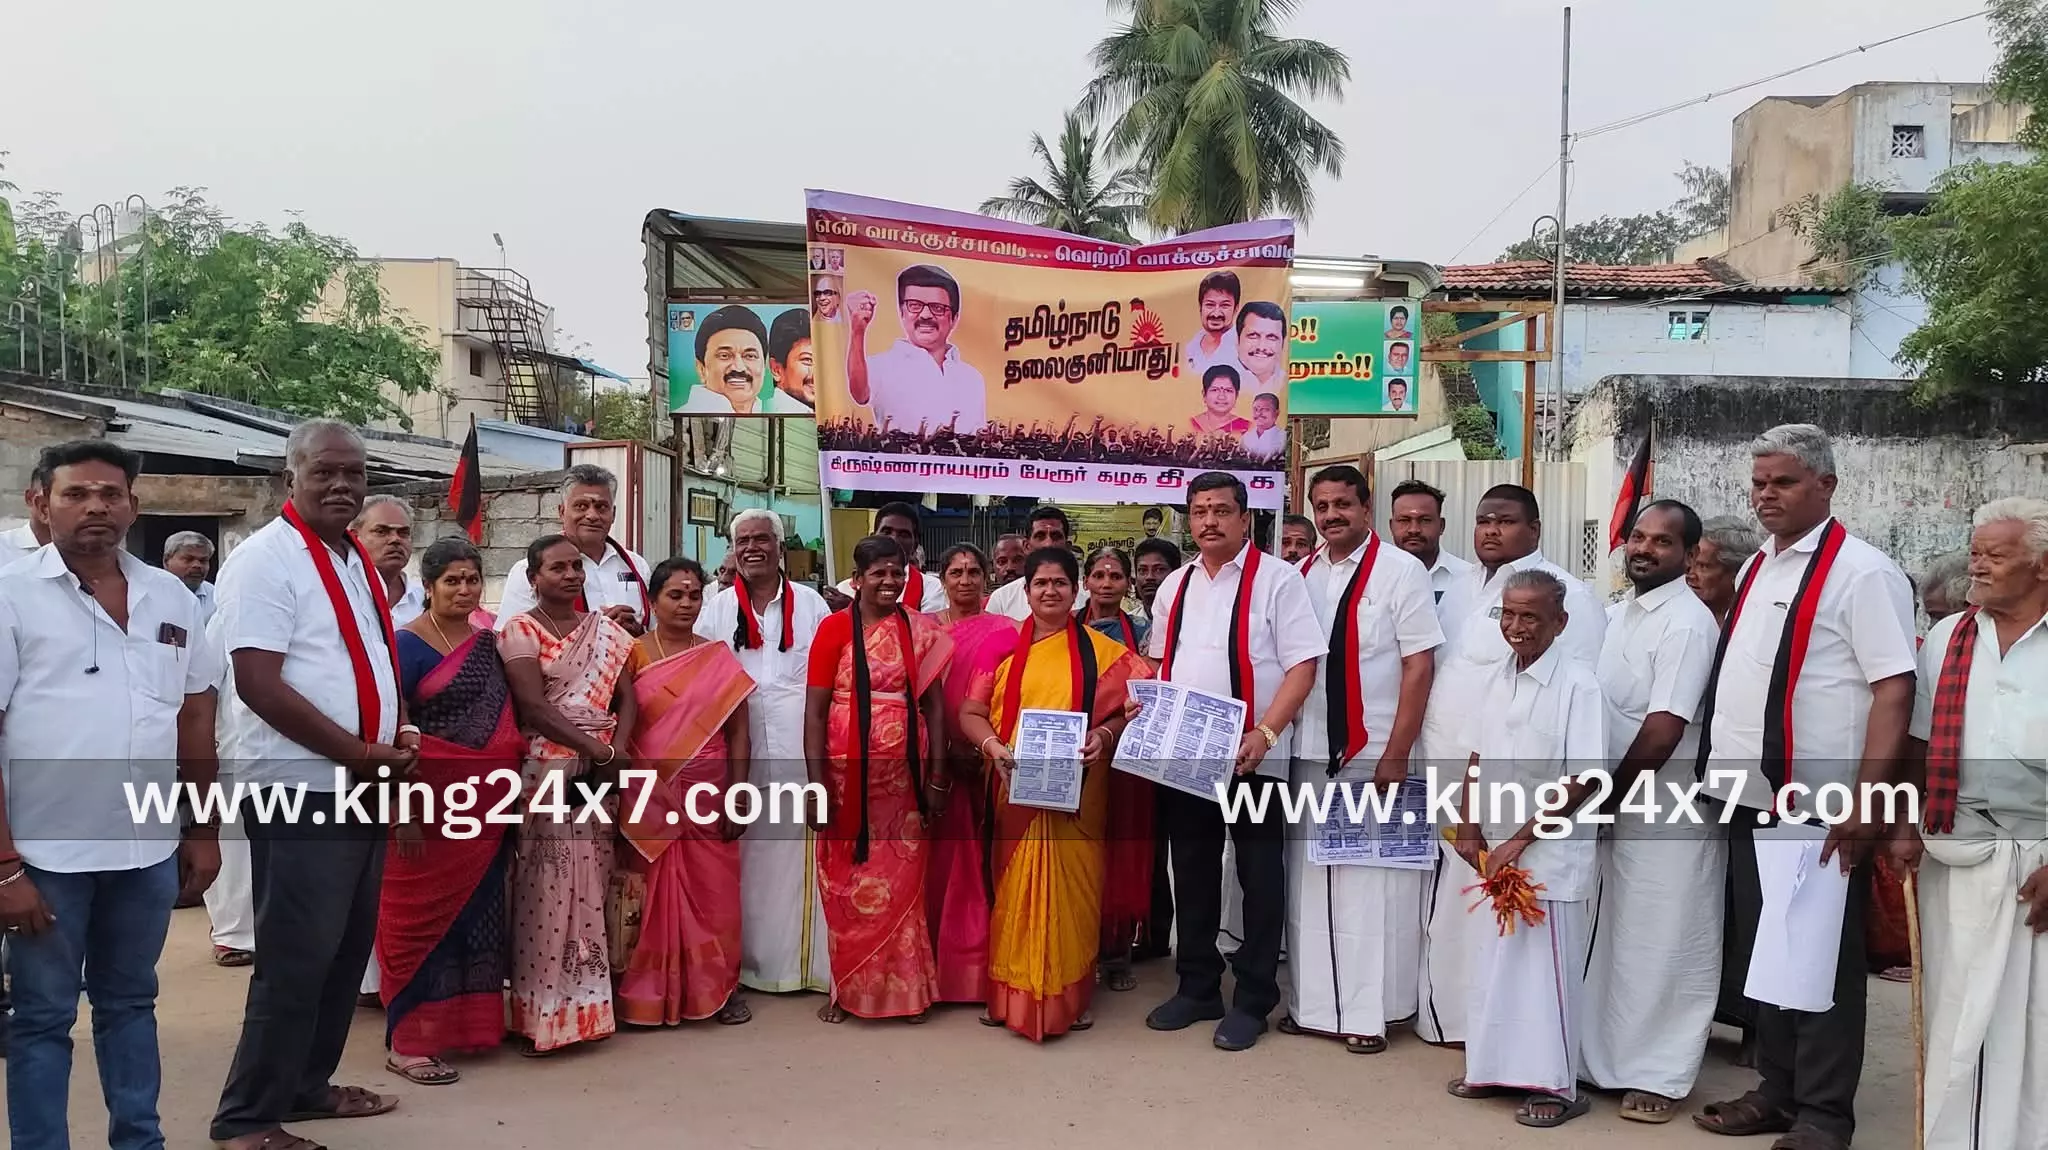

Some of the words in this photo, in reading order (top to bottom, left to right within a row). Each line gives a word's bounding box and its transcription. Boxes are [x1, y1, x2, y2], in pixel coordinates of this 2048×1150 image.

[815, 216, 858, 237] என்
[1055, 245, 1131, 269] வெற்றி
[1004, 298, 1122, 351] தமிழ்நாடு
[1003, 342, 1180, 389] தலைகுனியாது!
[830, 455, 1009, 479] கிருஷ்ணராயபுரம்
[1020, 464, 1088, 484] பேரூர்
[1097, 468, 1147, 487] கழக
